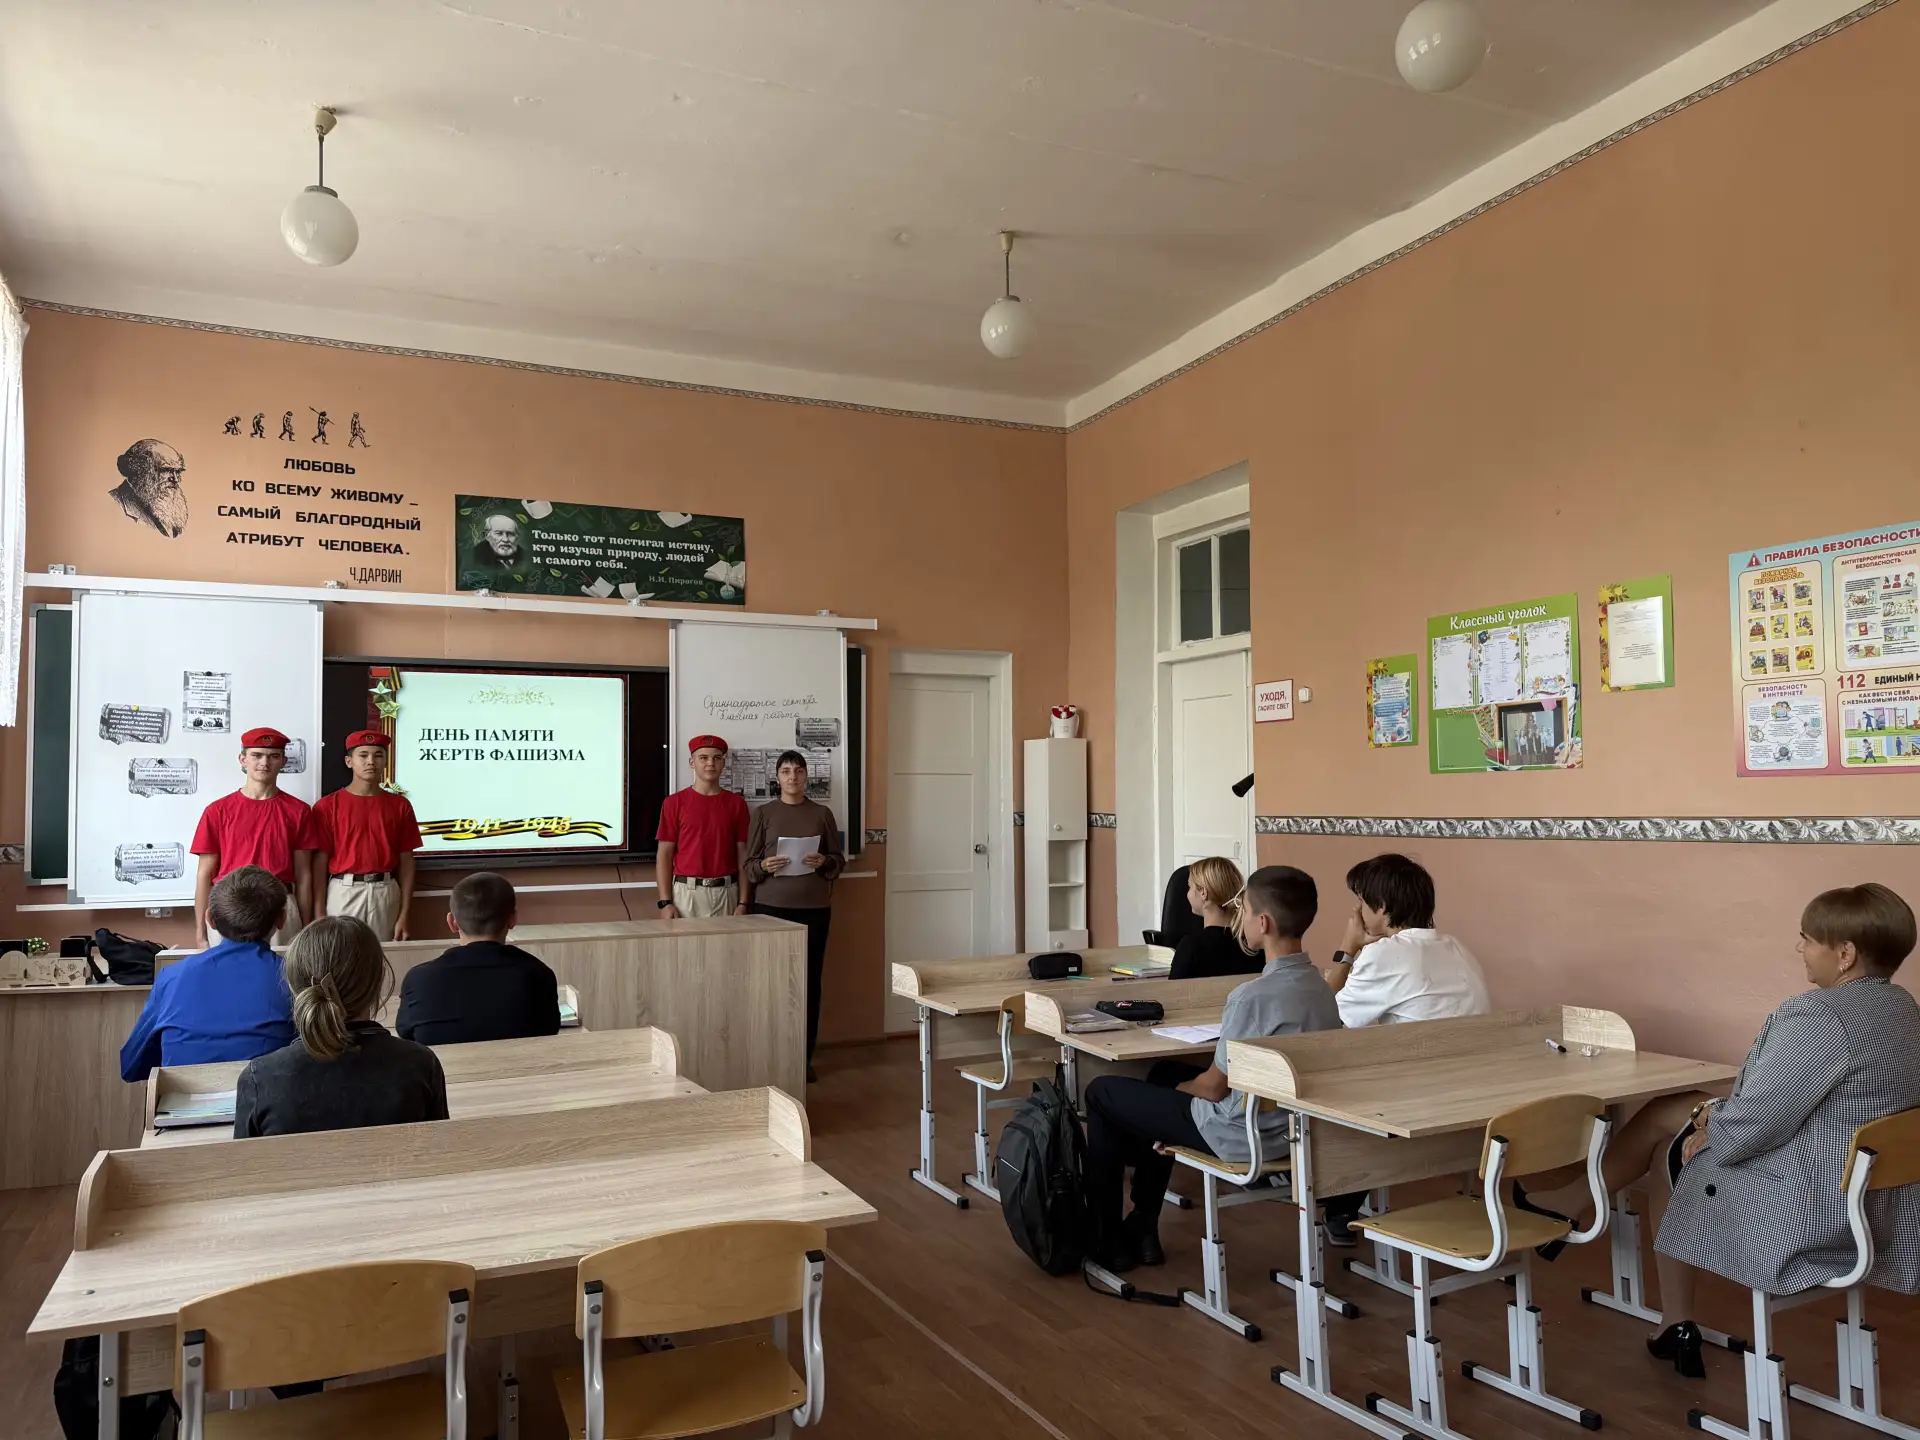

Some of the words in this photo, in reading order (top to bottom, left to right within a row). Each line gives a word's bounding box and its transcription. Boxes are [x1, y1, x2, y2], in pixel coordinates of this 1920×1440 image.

[284, 457, 356, 475] ЛЮБОВЬ
[232, 480, 255, 493] КО
[265, 482, 322, 498] ВСЕМУ
[330, 487, 404, 506] ЖИВОМУ
[217, 504, 281, 521] САМЫЙ
[295, 510, 421, 531] БЛАГОРОДНЫЙ
[226, 532, 305, 548] АТРИБУТ
[318, 539, 411, 556] ЧЕЛОВЕКА.
[532, 529, 579, 542] Только
[583, 533, 606, 543] тот
[609, 536, 664, 549] постигал
[668, 540, 715, 554] истину,
[532, 543, 556, 553] кто
[560, 545, 603, 557] изучал
[607, 548, 662, 562] природу,
[666, 551, 705, 563] людей
[1764, 544, 1820, 563] ПРАВИЛА
[1840, 549, 1917, 566] АНТИТЕРРОРИСТИЧЕСКАЯ
[532, 556, 542, 564] и
[545, 557, 592, 567] самого
[595, 558, 628, 569] себя.
[1855, 558, 1902, 569] БЕЗОПАСНОСТЬ
[349, 567, 402, 584] Ч.ДАРВИН
[1754, 572, 1805, 585] БЕЗОПАСНОСТЬ
[1760, 566, 1797, 578] ПОЖАРНАЯ
[668, 576, 704, 586] Пирогов
[1450, 610, 1506, 631] Классный
[1507, 604, 1547, 625] уголок
[1837, 673, 1866, 689] 112
[1874, 671, 1914, 685] ЕДИНЫЙ
[1758, 683, 1807, 693] БЕЗОПАСНОСТЬ
[1767, 690, 1804, 698] ИНТЕРНЕТЕ
[1260, 690, 1287, 702] УХОДЯ,
[1847, 697, 1898, 705] НЕЗНАКОМЫМИ
[1257, 703, 1276, 712] ГАСИТЕ
[1276, 702, 1289, 710] СВЕТ
[418, 728, 470, 742] ДЕНЬ
[474, 728, 555, 742] ПАМЯТИ
[418, 748, 485, 761] ЖЕРТВ
[489, 748, 586, 761] ФАШИЗМА
[452, 817, 502, 834] 1941
[521, 816, 572, 832] 1945
